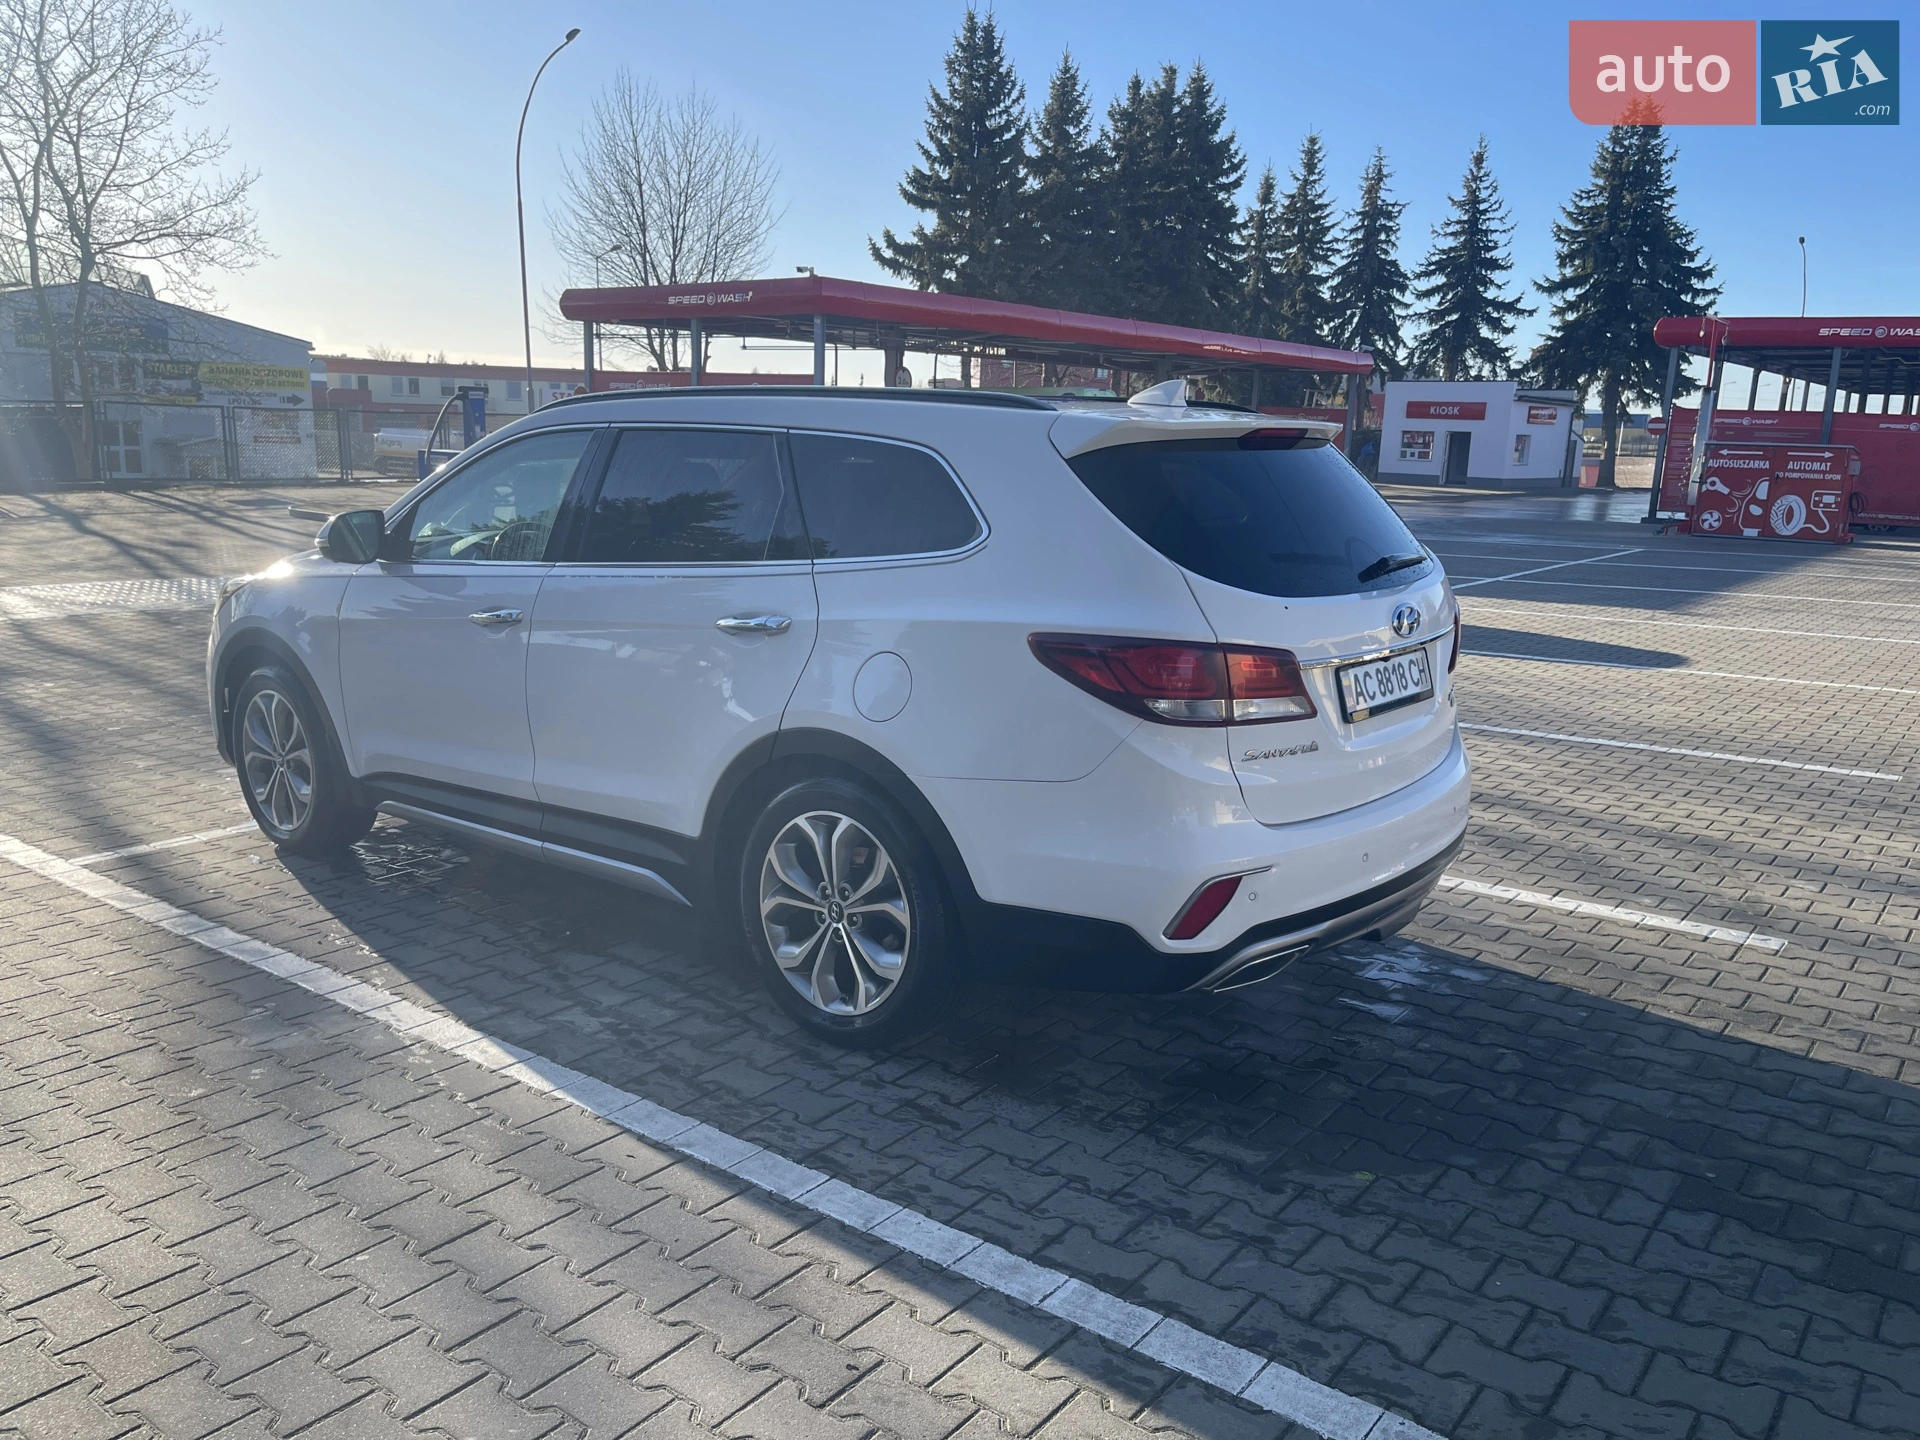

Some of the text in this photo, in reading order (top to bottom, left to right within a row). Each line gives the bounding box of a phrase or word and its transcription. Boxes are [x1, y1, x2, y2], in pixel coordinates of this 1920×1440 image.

[668, 291, 753, 305] SPEED WASH
[1818, 328, 1873, 336] SPEED
[1430, 406, 1460, 415] KIOSK
[1707, 459, 1770, 469] AUTOSUSZARKA
[1787, 461, 1832, 471] AUTOMAT
[1784, 472, 1824, 480] POMPOWANIA
[1353, 671, 1376, 706] AC
[1375, 662, 1409, 697] 8818
[1408, 656, 1428, 688] CH
